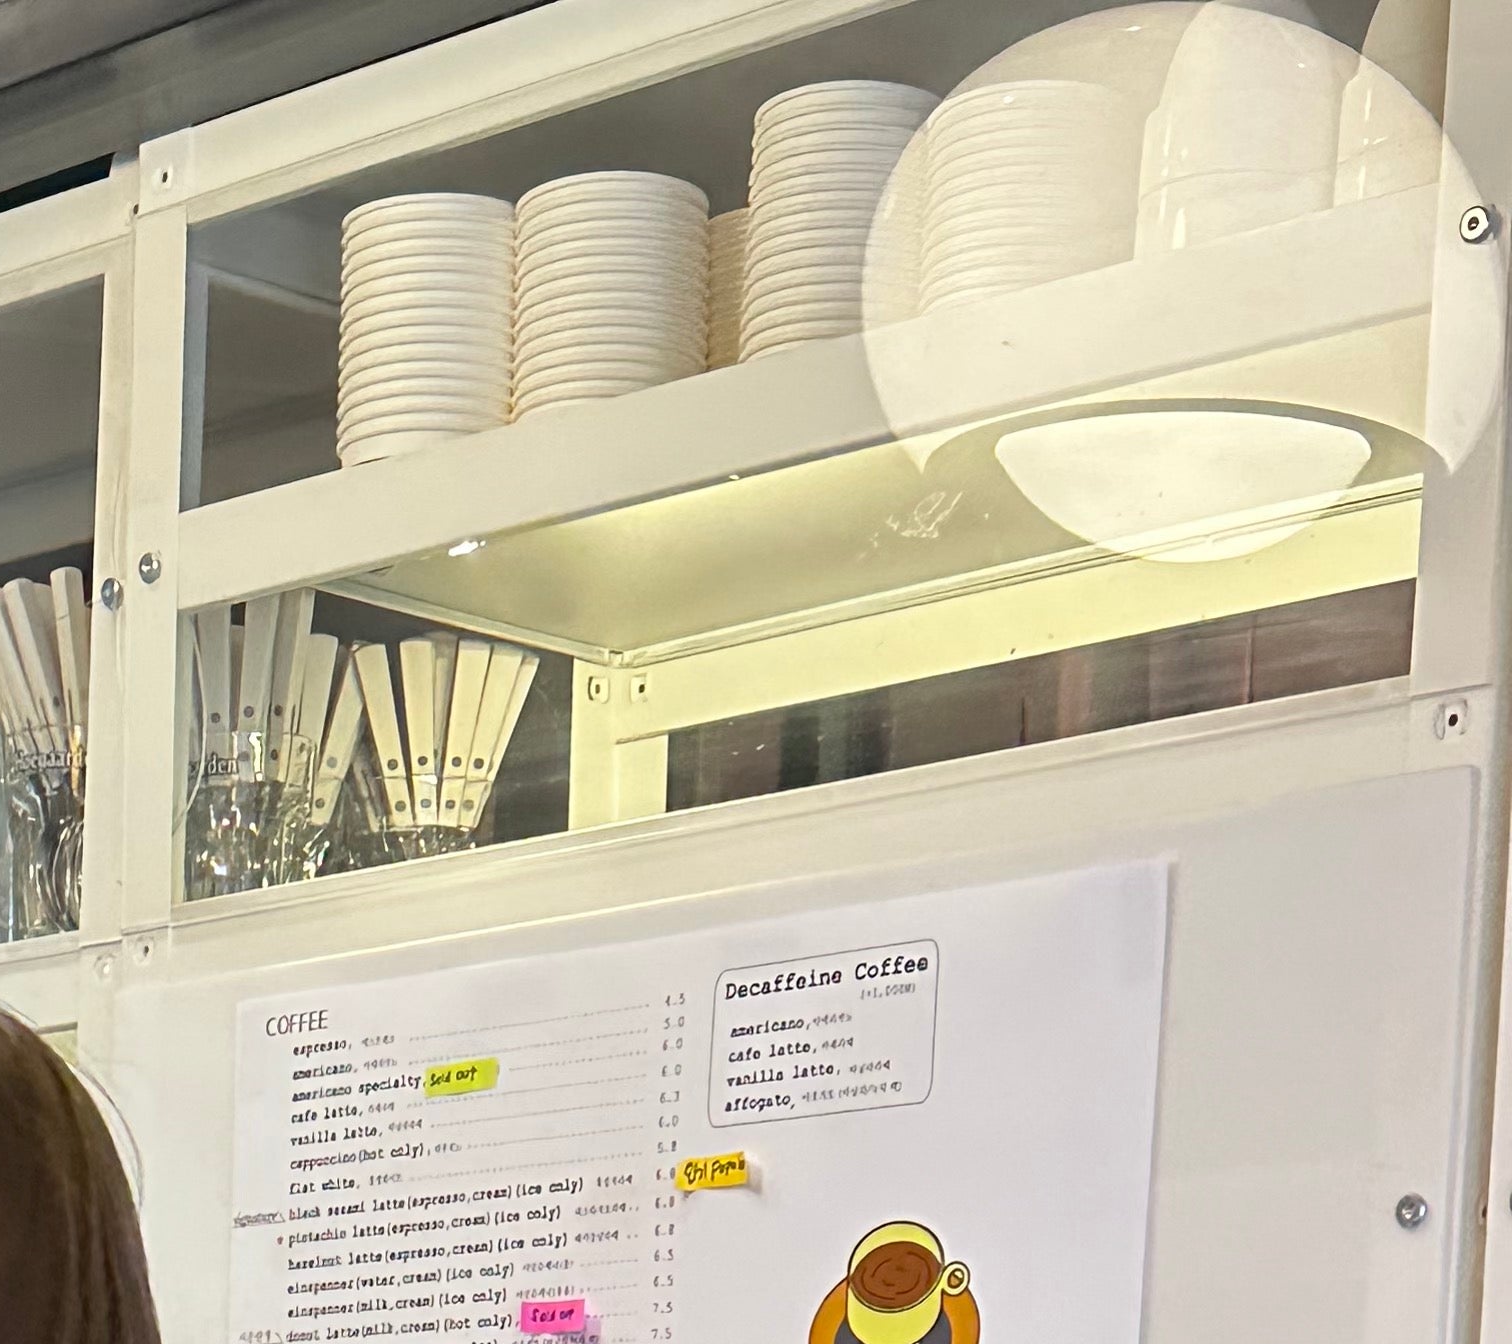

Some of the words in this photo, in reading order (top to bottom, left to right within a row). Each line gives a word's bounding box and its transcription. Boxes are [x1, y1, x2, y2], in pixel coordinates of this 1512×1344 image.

[725, 969, 842, 999] Decaffeine
[855, 956, 928, 980] Coffee
[266, 1010, 328, 1036] COFFEE
